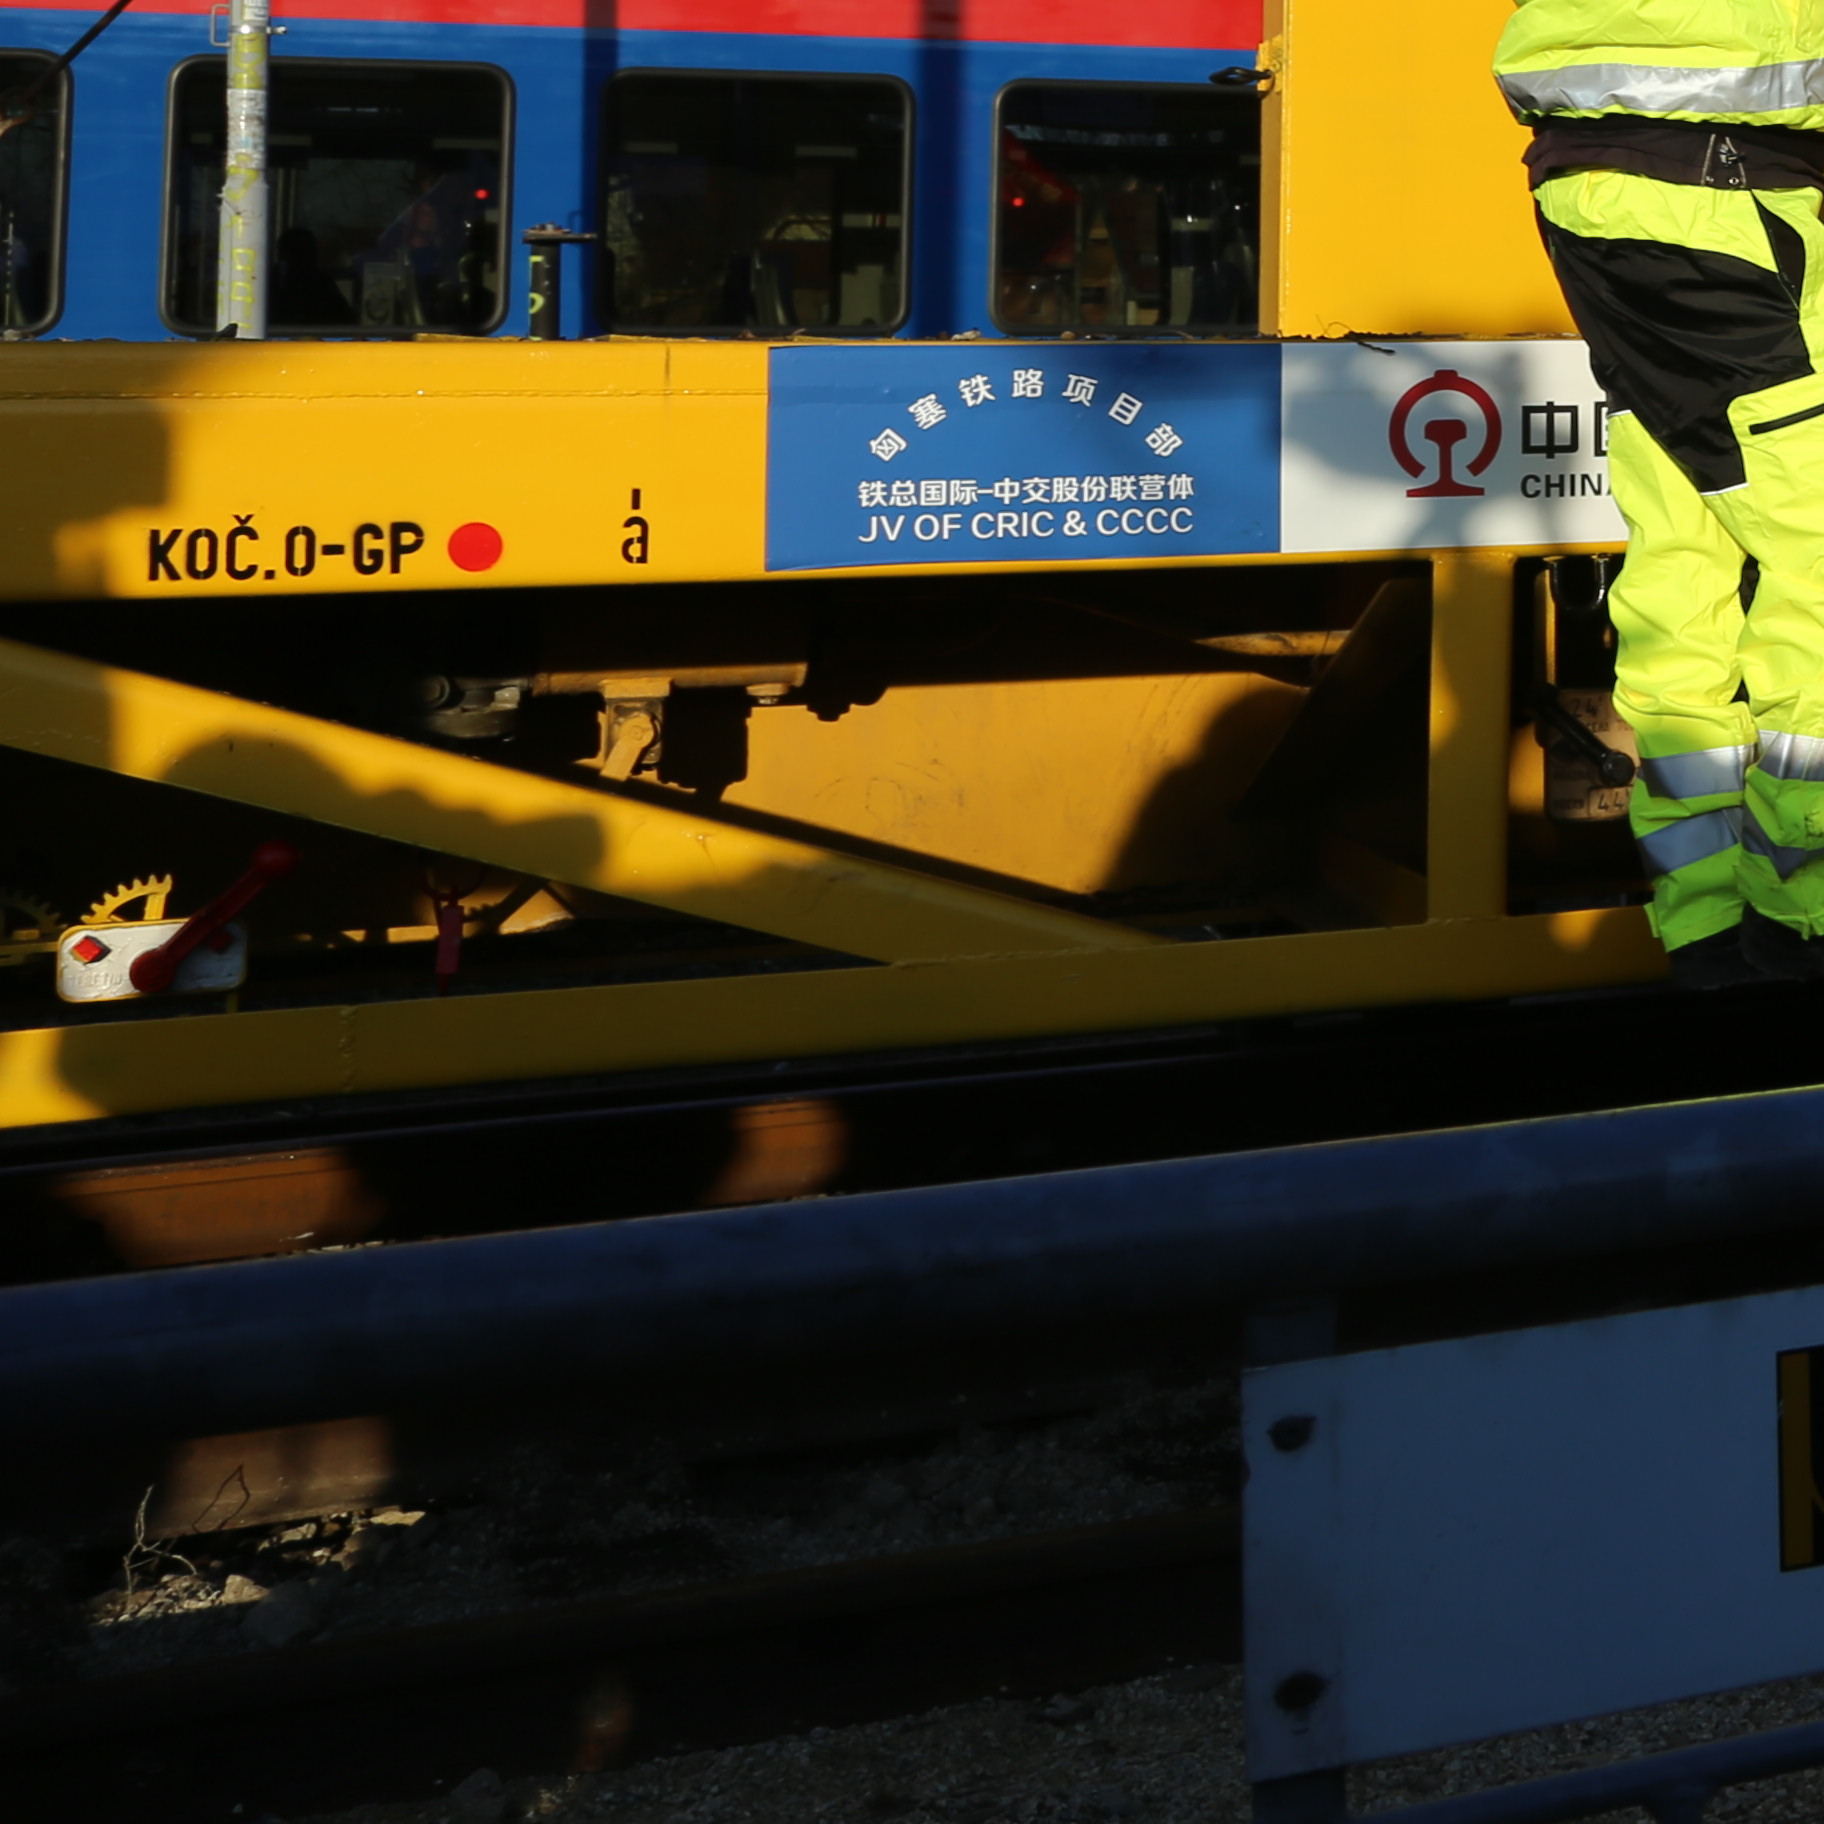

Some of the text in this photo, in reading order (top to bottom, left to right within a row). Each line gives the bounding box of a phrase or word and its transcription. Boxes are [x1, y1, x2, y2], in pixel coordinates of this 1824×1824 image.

[870, 368, 1184, 462] 匈塞铁路项目部
[1520, 473, 1612, 499] CHIN
[859, 507, 1193, 543] JV OF CRIC & CCCC
